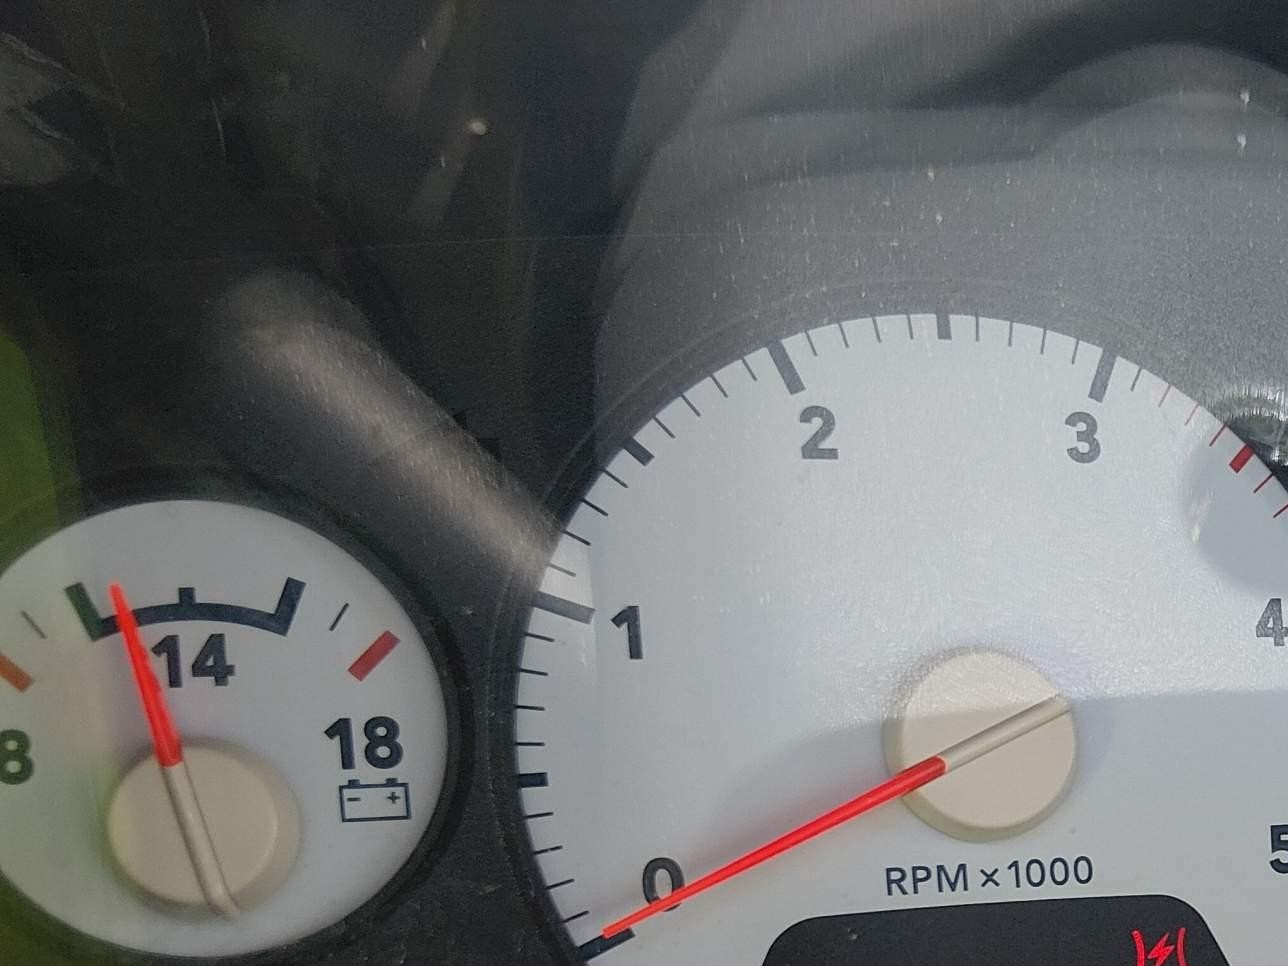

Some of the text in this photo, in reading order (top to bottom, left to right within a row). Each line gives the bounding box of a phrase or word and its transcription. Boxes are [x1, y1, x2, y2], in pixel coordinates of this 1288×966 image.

[799, 406, 839, 460] 2
[1064, 411, 1101, 463] 3
[610, 606, 644, 660] 1
[150, 633, 236, 689] 14
[0, 729, 34, 785] 8
[324, 715, 405, 770] 18
[642, 857, 686, 912] 0
[886, 863, 969, 896] RPM
